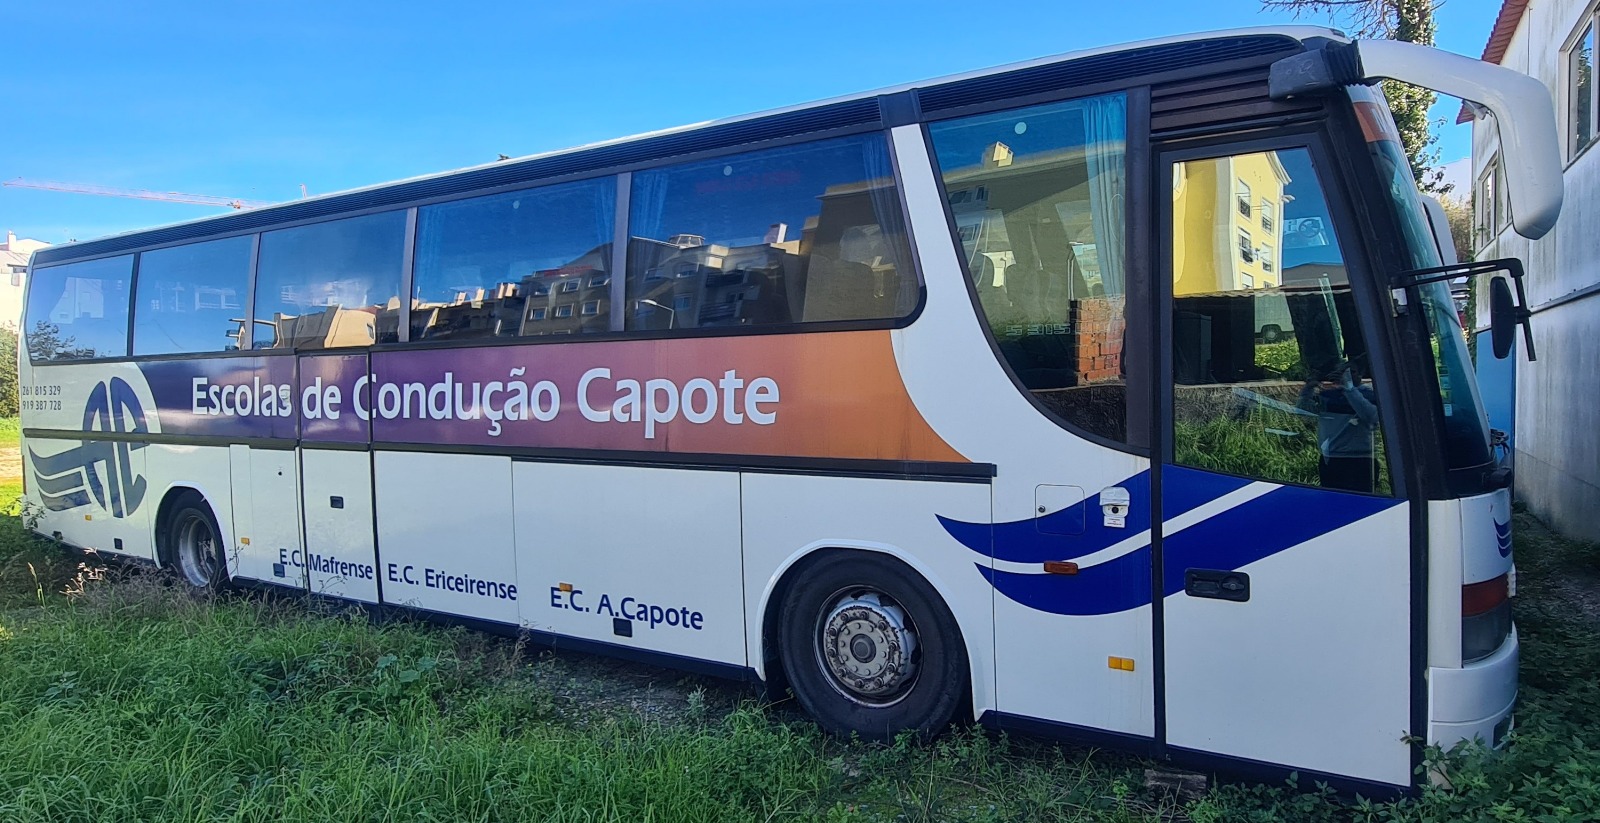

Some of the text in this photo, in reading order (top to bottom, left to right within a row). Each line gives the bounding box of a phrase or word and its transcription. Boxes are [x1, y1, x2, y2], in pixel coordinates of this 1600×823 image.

[22, 385, 61, 395] 261 815 329
[22, 400, 62, 410] 919 387 728
[192, 366, 780, 439] Escolas de Condução Capote
[279, 548, 373, 580] E.C. Mafrense
[388, 563, 518, 601] E.C. Ericeirense
[550, 586, 704, 631] E.C. A.Capote
